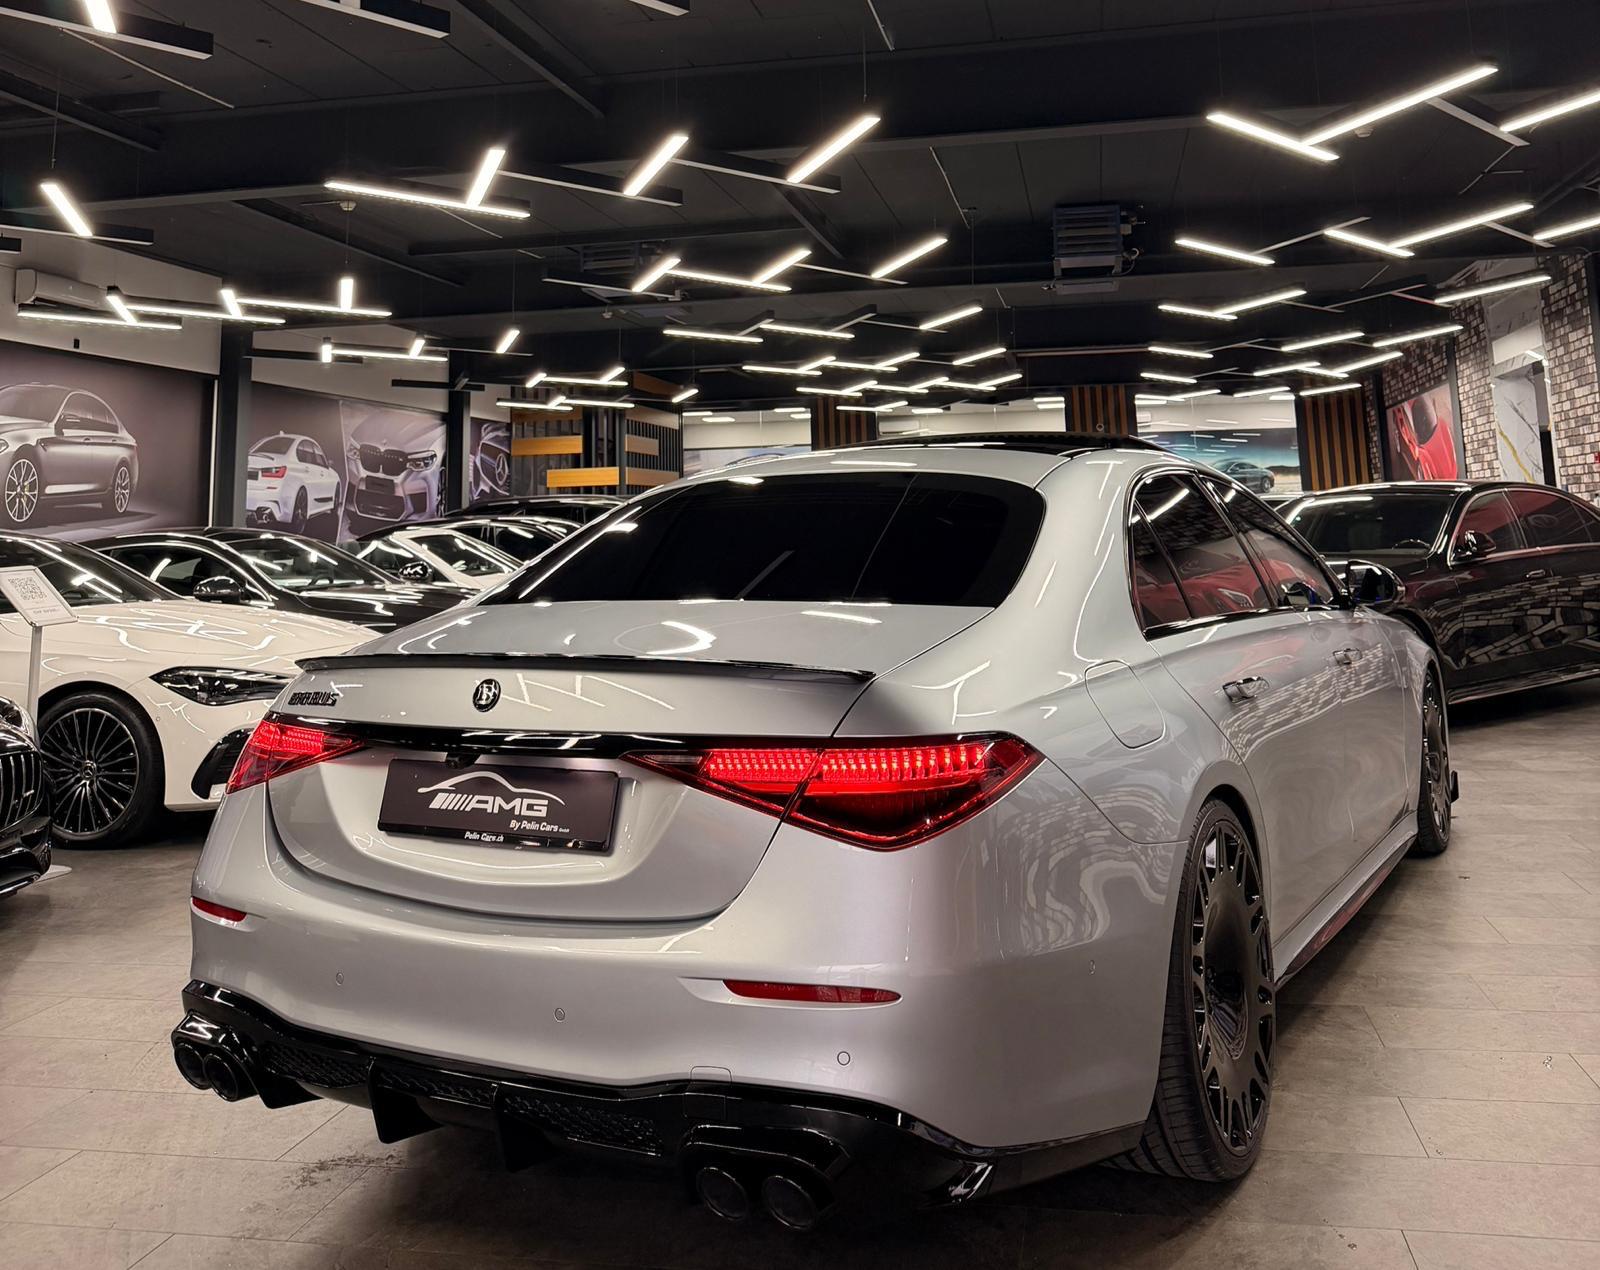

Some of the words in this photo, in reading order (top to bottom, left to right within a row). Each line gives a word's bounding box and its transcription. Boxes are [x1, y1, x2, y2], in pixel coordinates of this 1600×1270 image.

[509, 819, 521, 831] By
[520, 820, 540, 831] Pelin
[540, 821, 559, 832] Cars
[464, 831, 480, 840] Pelin
